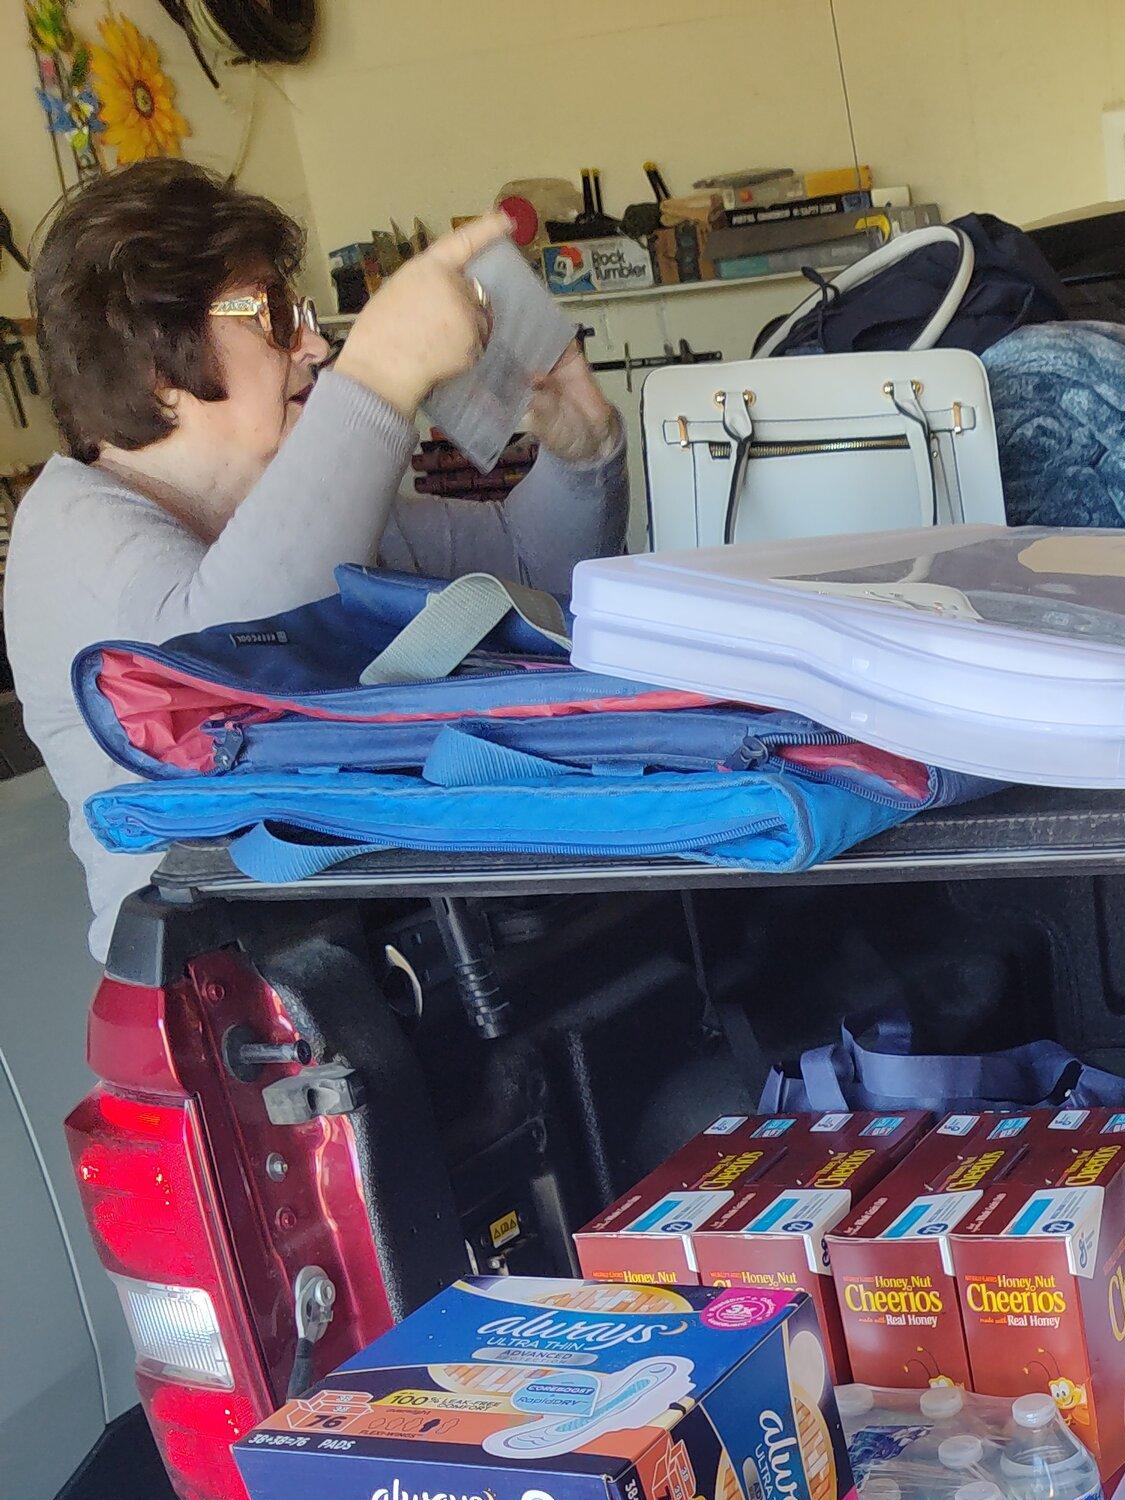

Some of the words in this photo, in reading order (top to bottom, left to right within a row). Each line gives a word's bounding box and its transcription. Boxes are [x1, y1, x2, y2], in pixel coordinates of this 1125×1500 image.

[591, 249, 625, 265] Rock
[623, 1270, 655, 1284] Honey
[658, 1271, 678, 1284] Nut
[742, 1271, 776, 1285] Honey
[778, 1272, 798, 1284] Nut
[875, 1275, 907, 1289] Honey
[911, 1276, 932, 1288] Nut
[998, 1275, 1030, 1289] Honey
[1034, 1275, 1055, 1288] Nut
[844, 1284, 943, 1313] Cheerios
[966, 1283, 1066, 1314] Cheerios
[886, 1315, 906, 1325] Real
[907, 1315, 938, 1327] Honey
[1007, 1315, 1028, 1326] Real
[1029, 1315, 1060, 1329] Honey
[477, 1311, 663, 1351] always
[487, 1336, 540, 1349] ULTRA
[545, 1341, 585, 1351] THIN
[500, 1349, 573, 1359] ADVANCED
[306, 1414, 347, 1429] 76
[248, 1433, 311, 1448] 38+38=76
[318, 1438, 356, 1451] PADS
[756, 1443, 774, 1497] ULTRA
